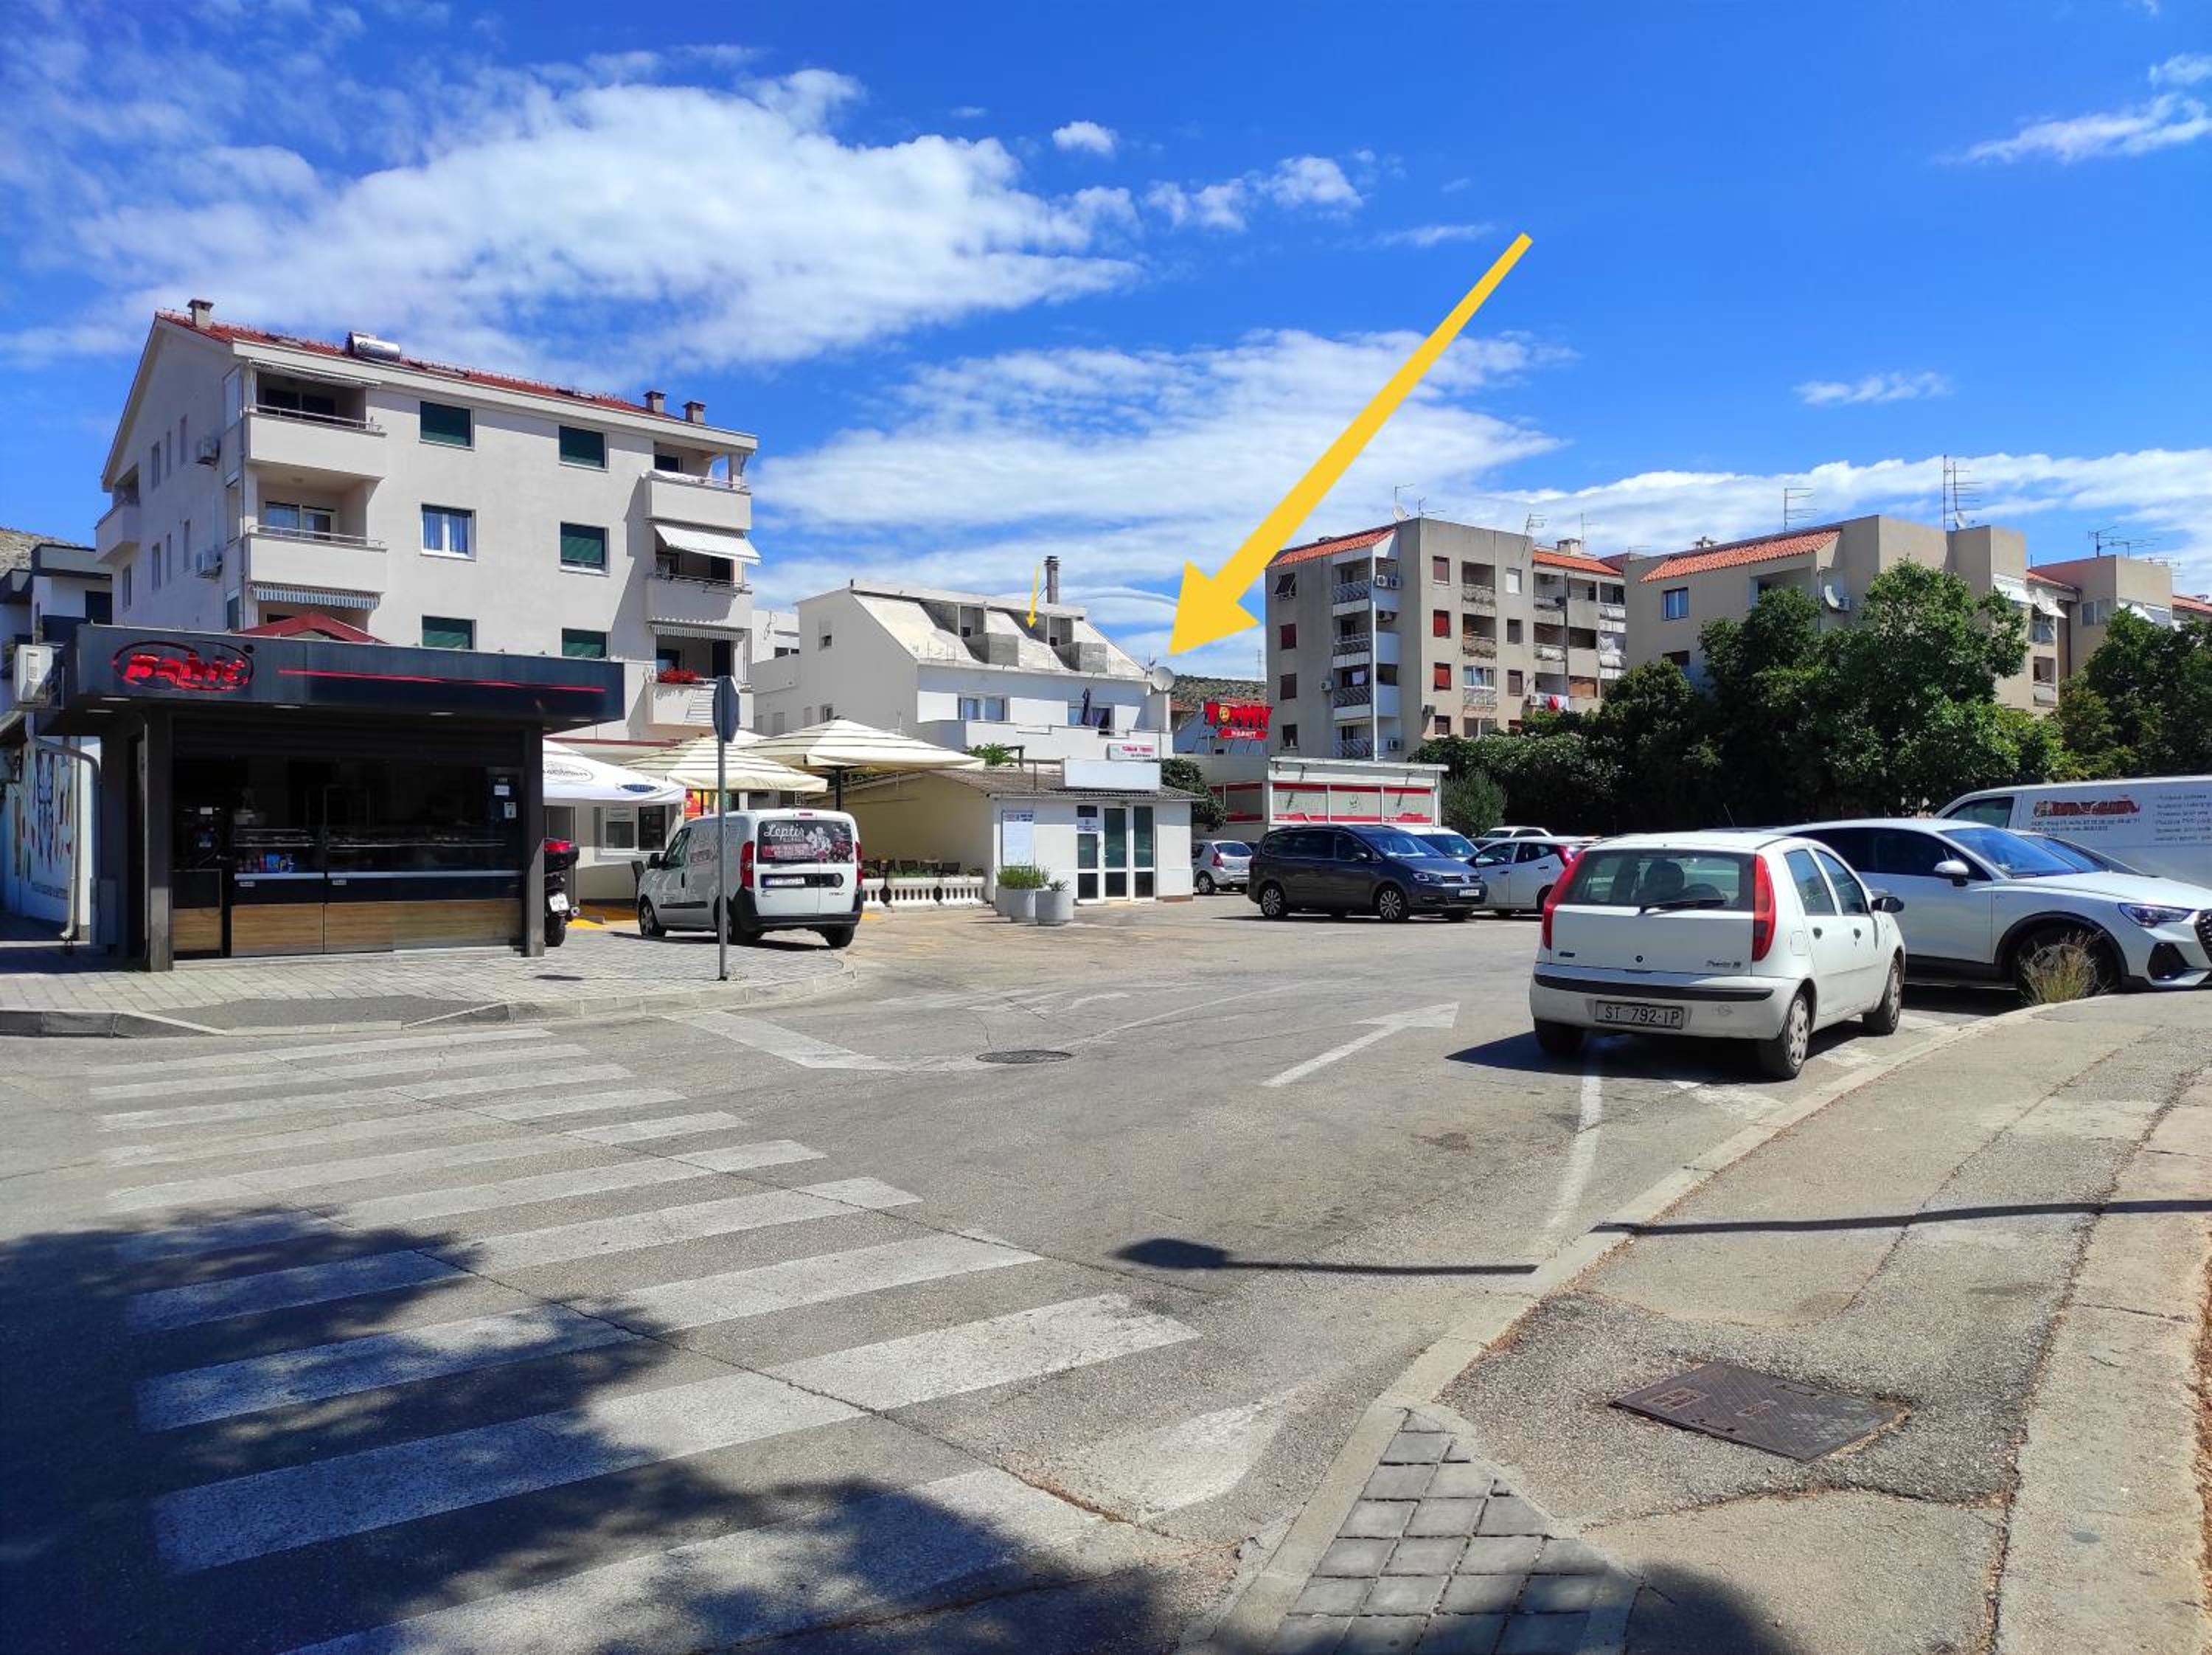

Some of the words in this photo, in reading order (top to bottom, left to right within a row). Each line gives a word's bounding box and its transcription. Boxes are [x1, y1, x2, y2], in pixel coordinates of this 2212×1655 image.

[1205, 702, 1273, 729] TOMMY
[1605, 1005, 1620, 1019] ST
[1630, 1007, 1680, 1025] 792-IP
